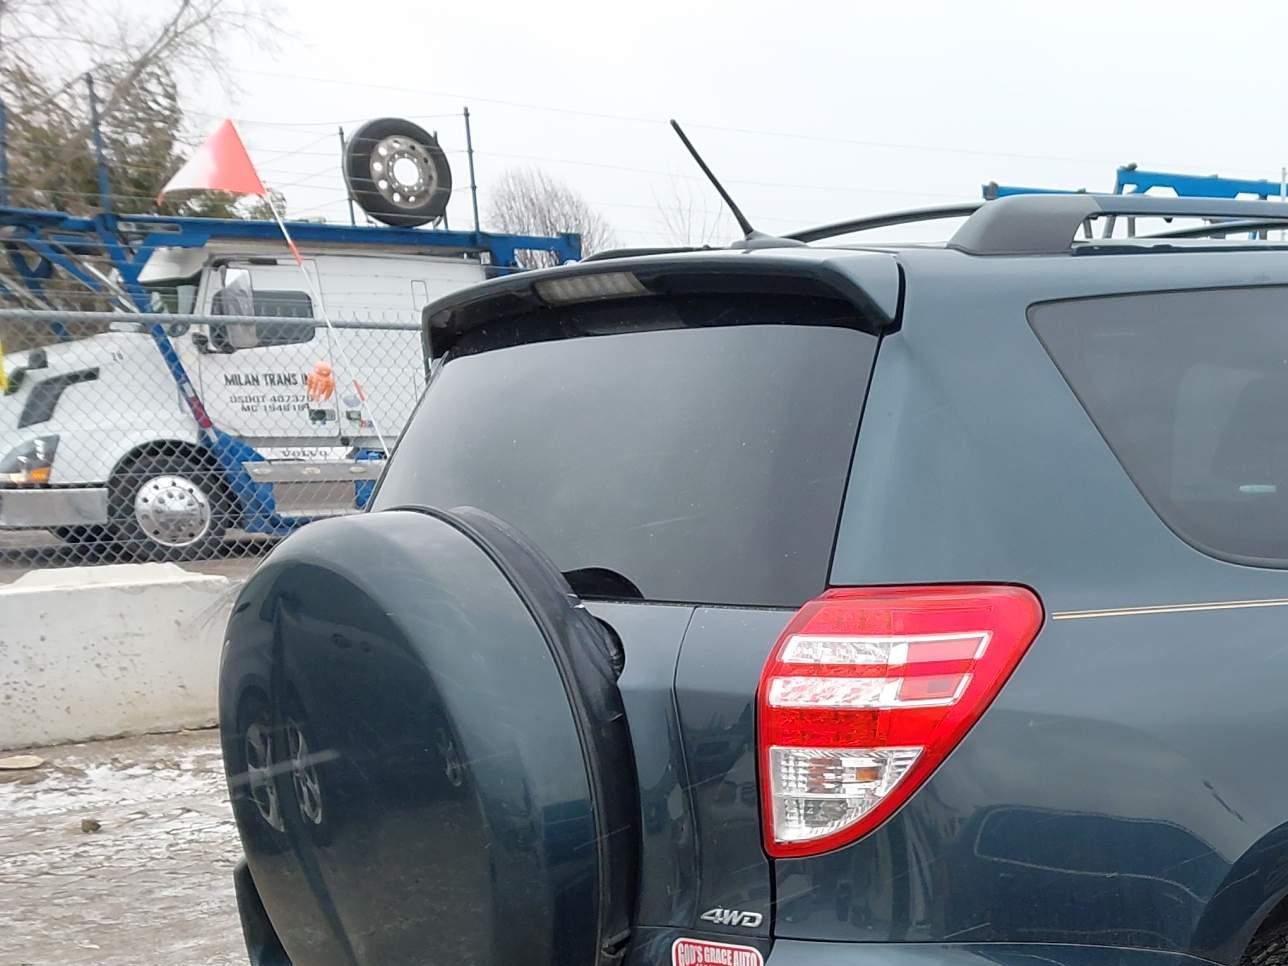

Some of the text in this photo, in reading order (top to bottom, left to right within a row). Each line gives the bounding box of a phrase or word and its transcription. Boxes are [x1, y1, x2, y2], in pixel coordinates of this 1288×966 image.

[224, 374, 260, 386] MILAN
[263, 373, 297, 386] TRANS
[230, 394, 265, 403] USDOT
[241, 404, 257, 412] MC
[700, 908, 763, 928] 4WD
[704, 946, 733, 966] GRACE
